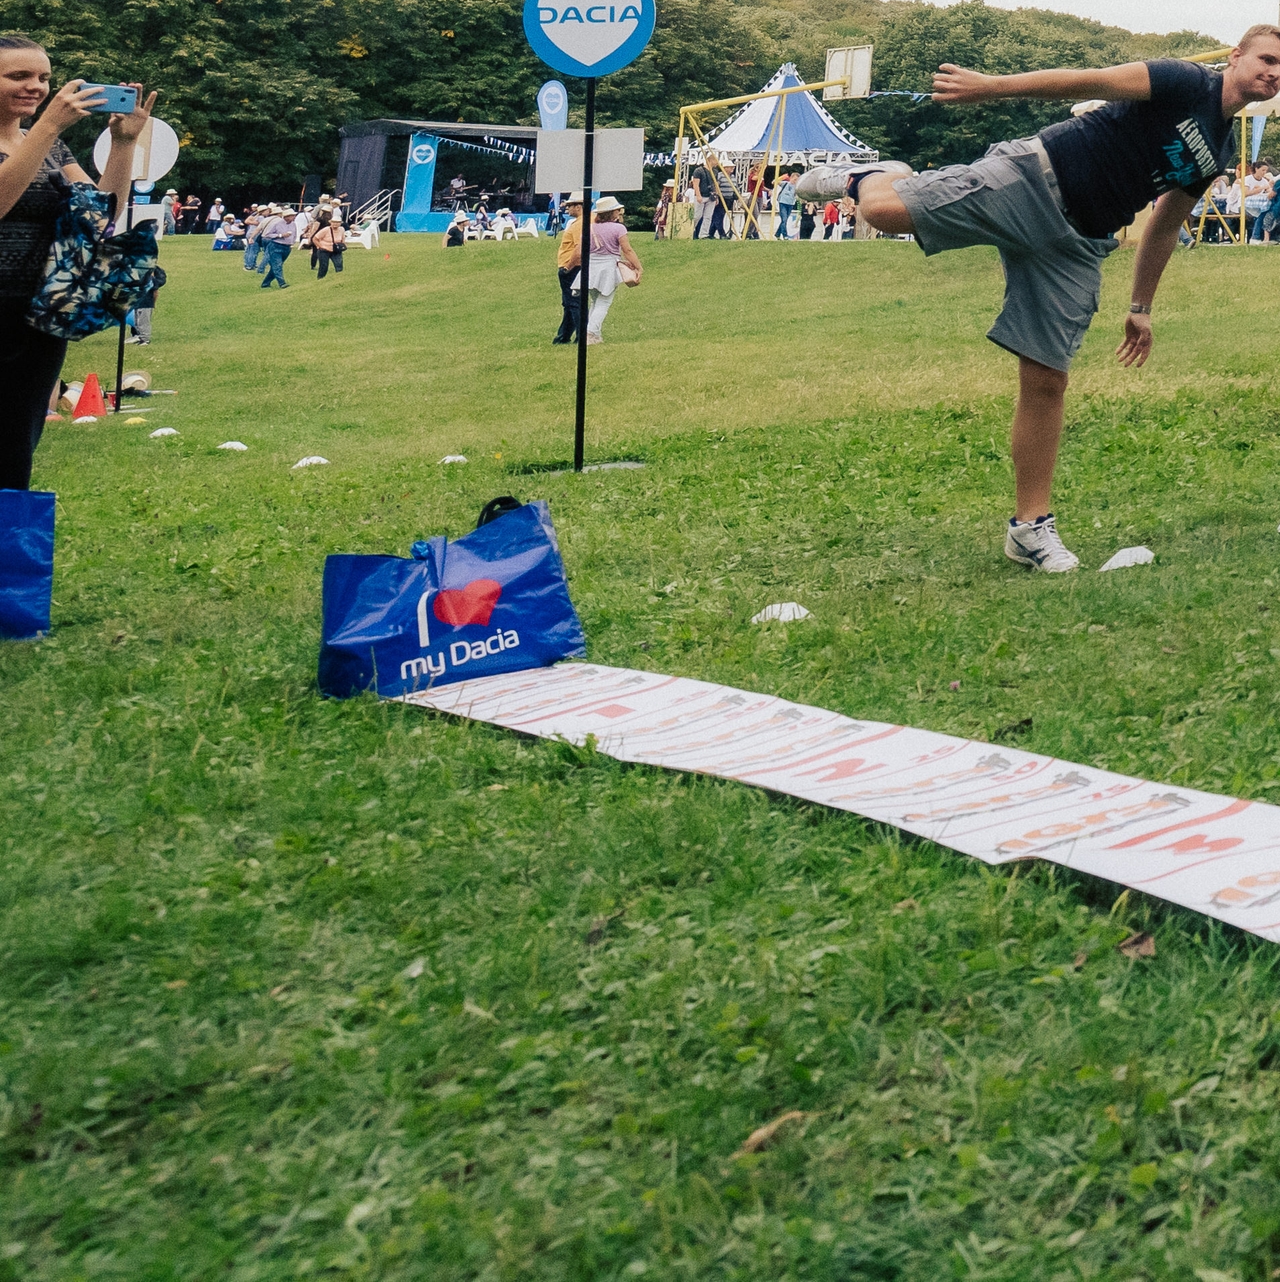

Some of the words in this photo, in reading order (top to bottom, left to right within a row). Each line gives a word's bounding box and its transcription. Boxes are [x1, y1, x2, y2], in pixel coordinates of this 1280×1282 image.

[537, 5, 643, 24] DACIA
[400, 652, 446, 680] my
[449, 628, 520, 666] Dacia
